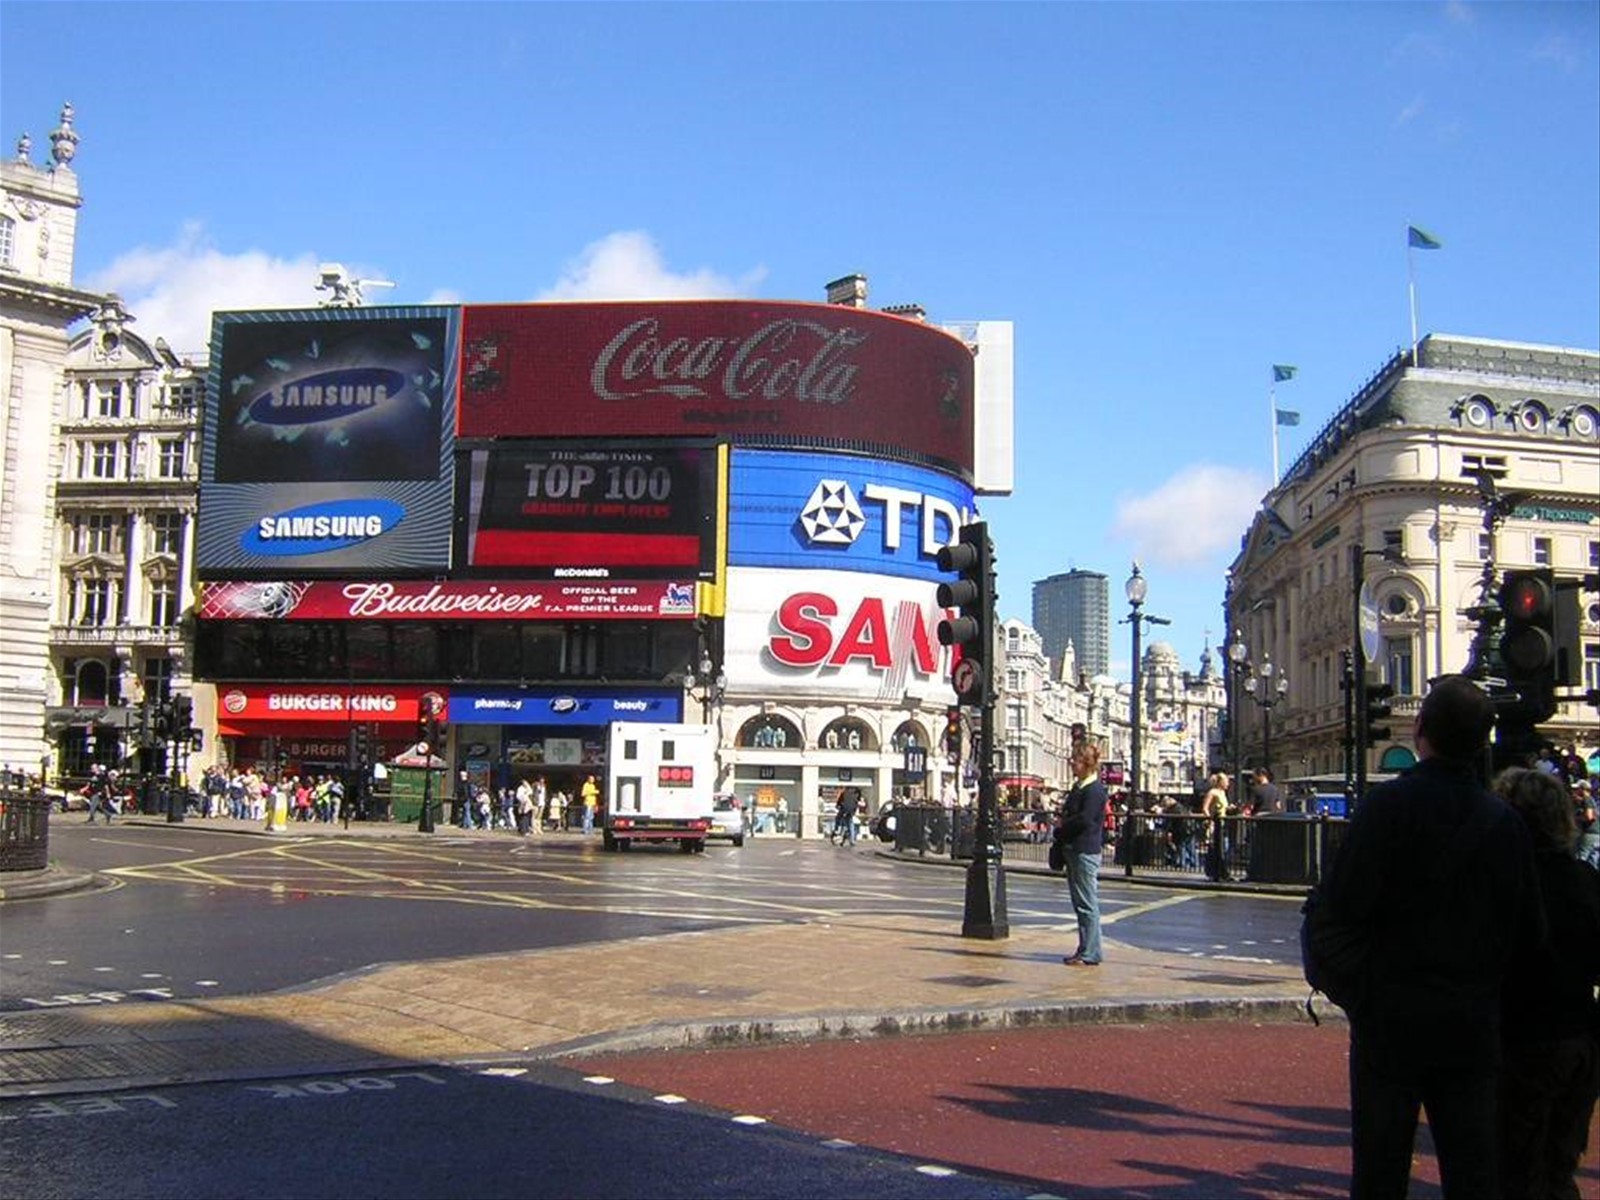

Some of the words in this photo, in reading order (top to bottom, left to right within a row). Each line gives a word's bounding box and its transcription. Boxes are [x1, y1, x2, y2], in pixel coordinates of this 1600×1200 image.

[269, 383, 387, 408] SAMSUNG
[611, 451, 653, 462] TIMES
[524, 463, 596, 499] TOP
[604, 465, 672, 501] 100
[259, 515, 382, 538] SAMSUNG
[554, 568, 609, 578] McDonald's
[561, 587, 607, 595] OFFICIAL
[609, 587, 637, 595] BEER
[342, 583, 542, 616] Budweiser
[581, 595, 596, 604] OF
[597, 595, 618, 604] THE
[565, 604, 611, 612] PREMIER
[612, 604, 654, 612] LEAGUE
[268, 694, 342, 711] BURGER
[345, 694, 397, 712] KING
[613, 700, 648, 711] beauty
[244, 1073, 447, 1099] LOOK
